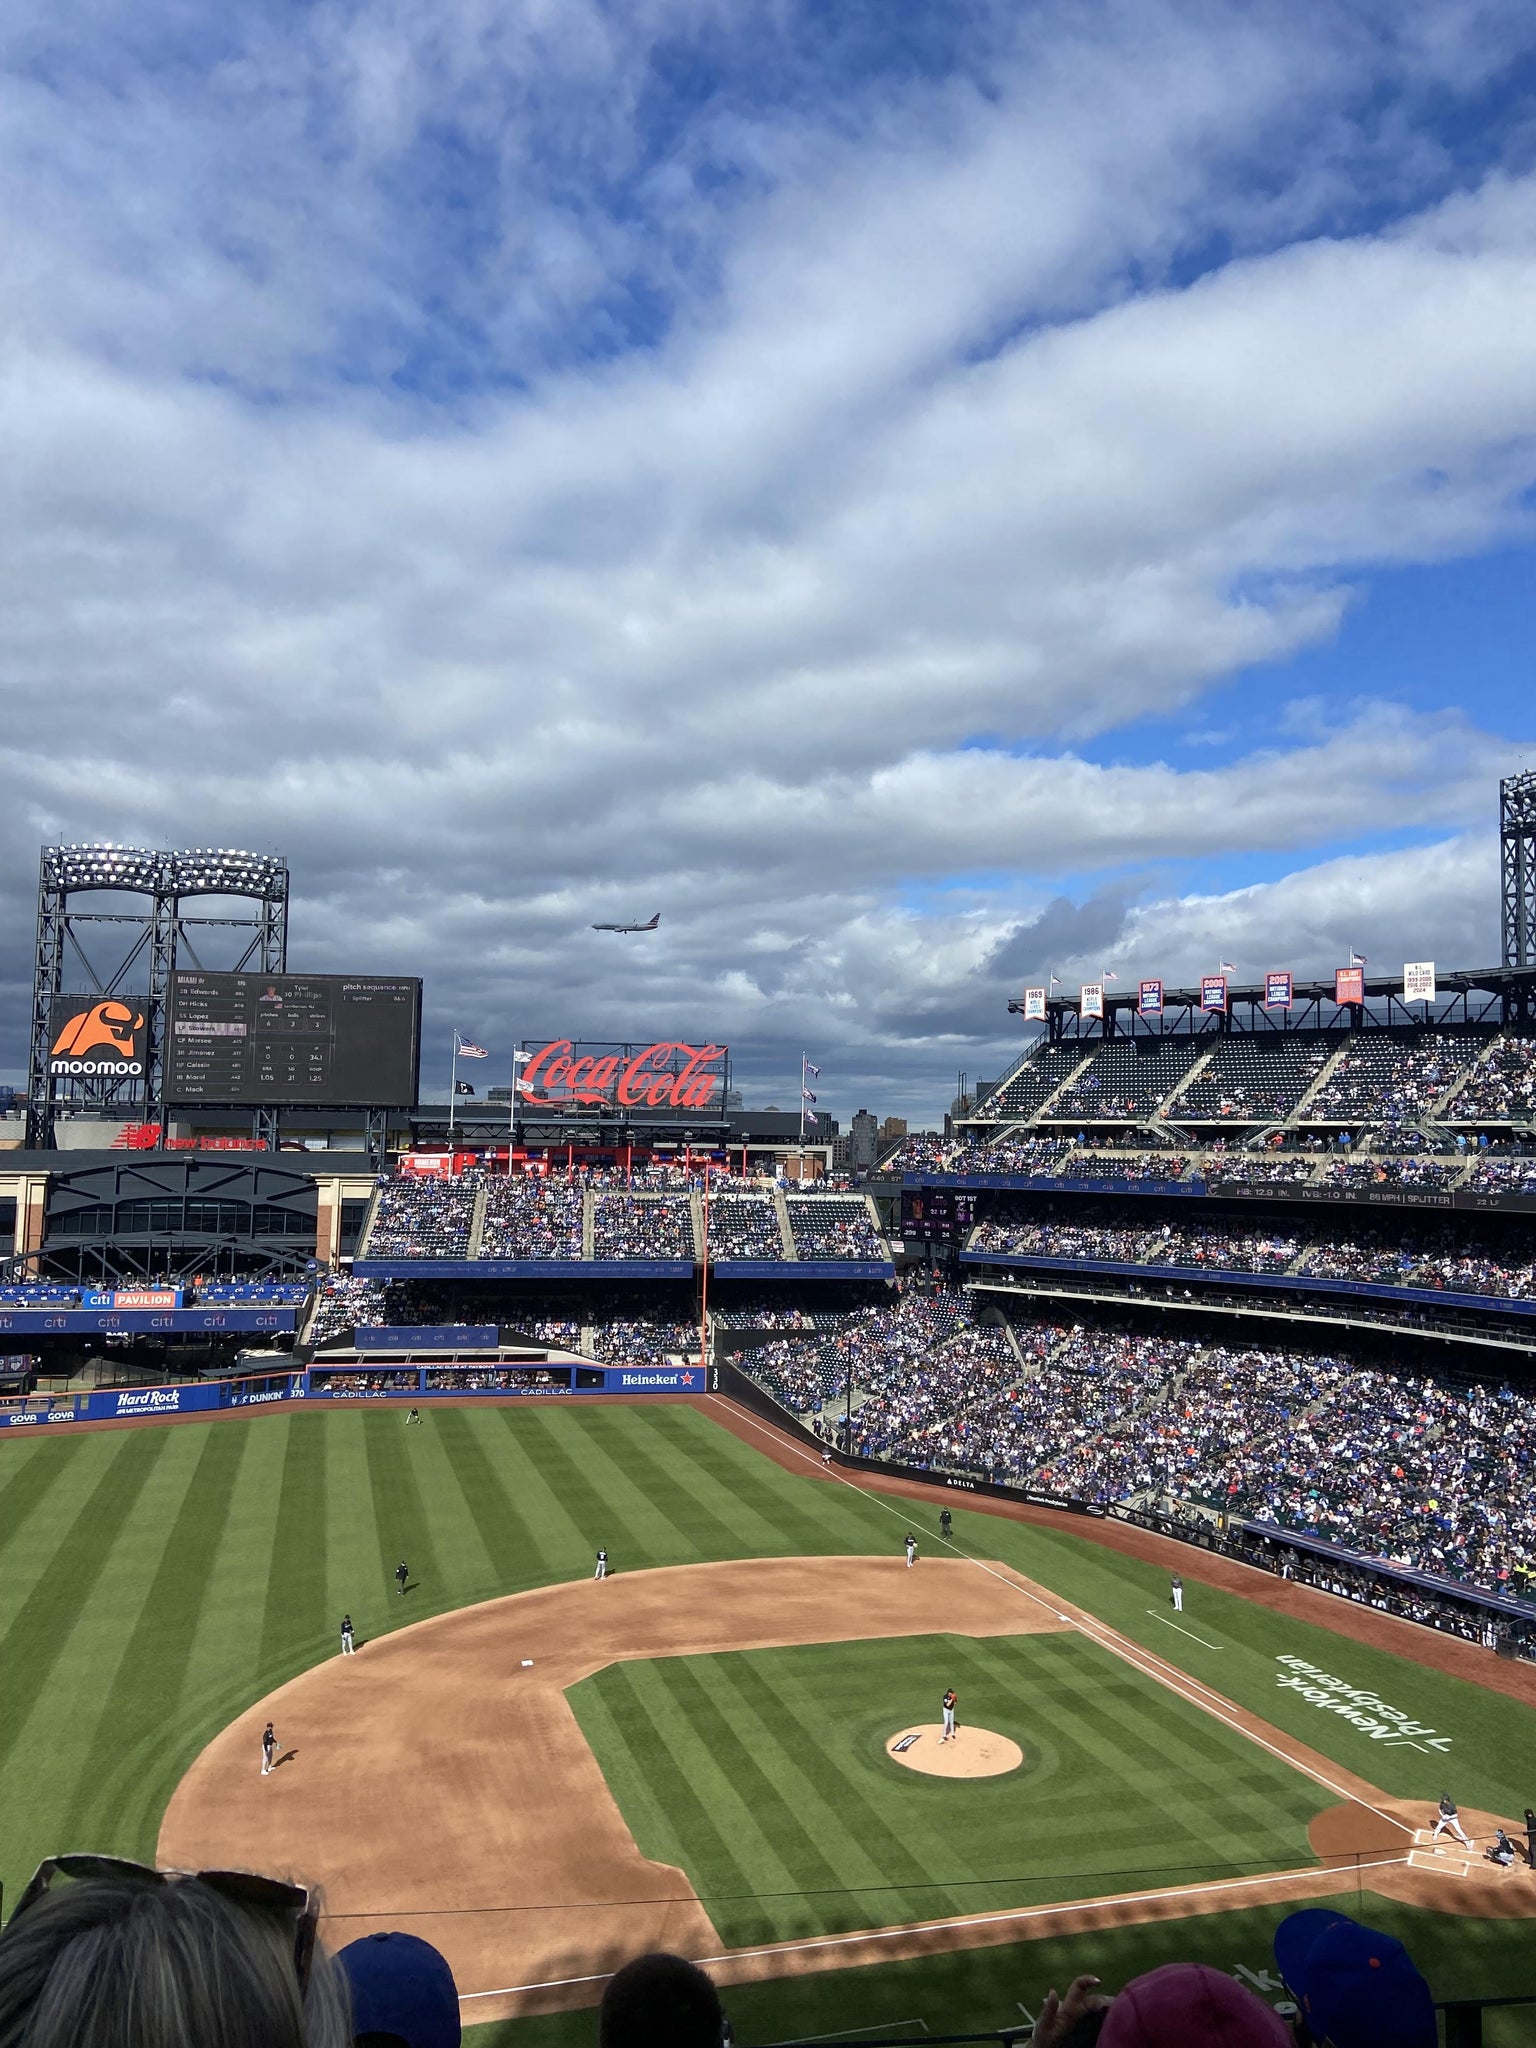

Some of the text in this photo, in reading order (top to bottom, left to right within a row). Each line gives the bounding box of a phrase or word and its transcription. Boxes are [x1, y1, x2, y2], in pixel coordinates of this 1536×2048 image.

[178, 976, 198, 984] MIAMI
[1204, 980, 1224, 988] 2000
[1269, 976, 1288, 984] 2015
[342, 984, 362, 992] pitch
[1084, 988, 1100, 996] 1986
[294, 992, 322, 1000] Phillips
[51, 1060, 142, 1076] moomoo
[522, 1040, 728, 1107] Coca-Cola
[164, 1136, 268, 1150] new balance
[1408, 1195, 1450, 1204] SPLITTER
[90, 1294, 171, 1304] citi PAVILION
[0, 1318, 12, 1328] iti
[44, 1316, 66, 1328] citi
[98, 1316, 120, 1328] citi
[152, 1316, 172, 1327] citi
[204, 1315, 226, 1326] citi
[256, 1314, 278, 1326] citi
[622, 1374, 677, 1385] Heineken
[118, 1390, 180, 1406] Hard Rock
[250, 1391, 283, 1403] DUNKIN'
[290, 1390, 304, 1398] 370
[126, 1406, 166, 1414] METROPOLITAN
[953, 1480, 974, 1488] DELTA
[1275, 1654, 1436, 1736] Presbyterian
